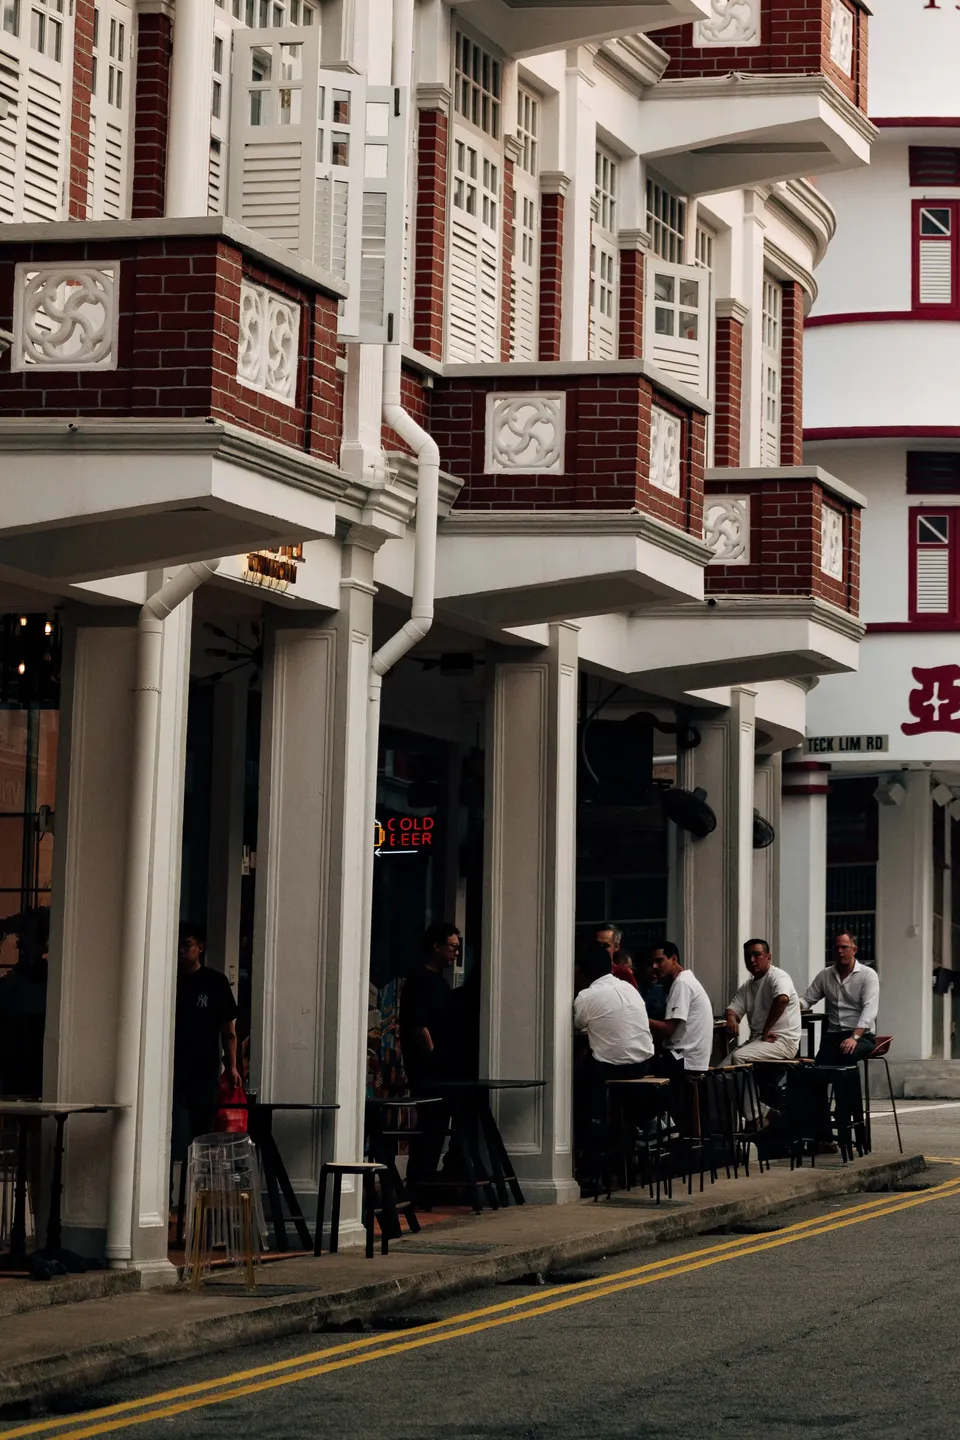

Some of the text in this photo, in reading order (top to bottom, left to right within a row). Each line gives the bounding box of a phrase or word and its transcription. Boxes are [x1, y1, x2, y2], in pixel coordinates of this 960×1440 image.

[807, 736, 883, 752] TECK LIM RD
[387, 817, 434, 831] COLD
